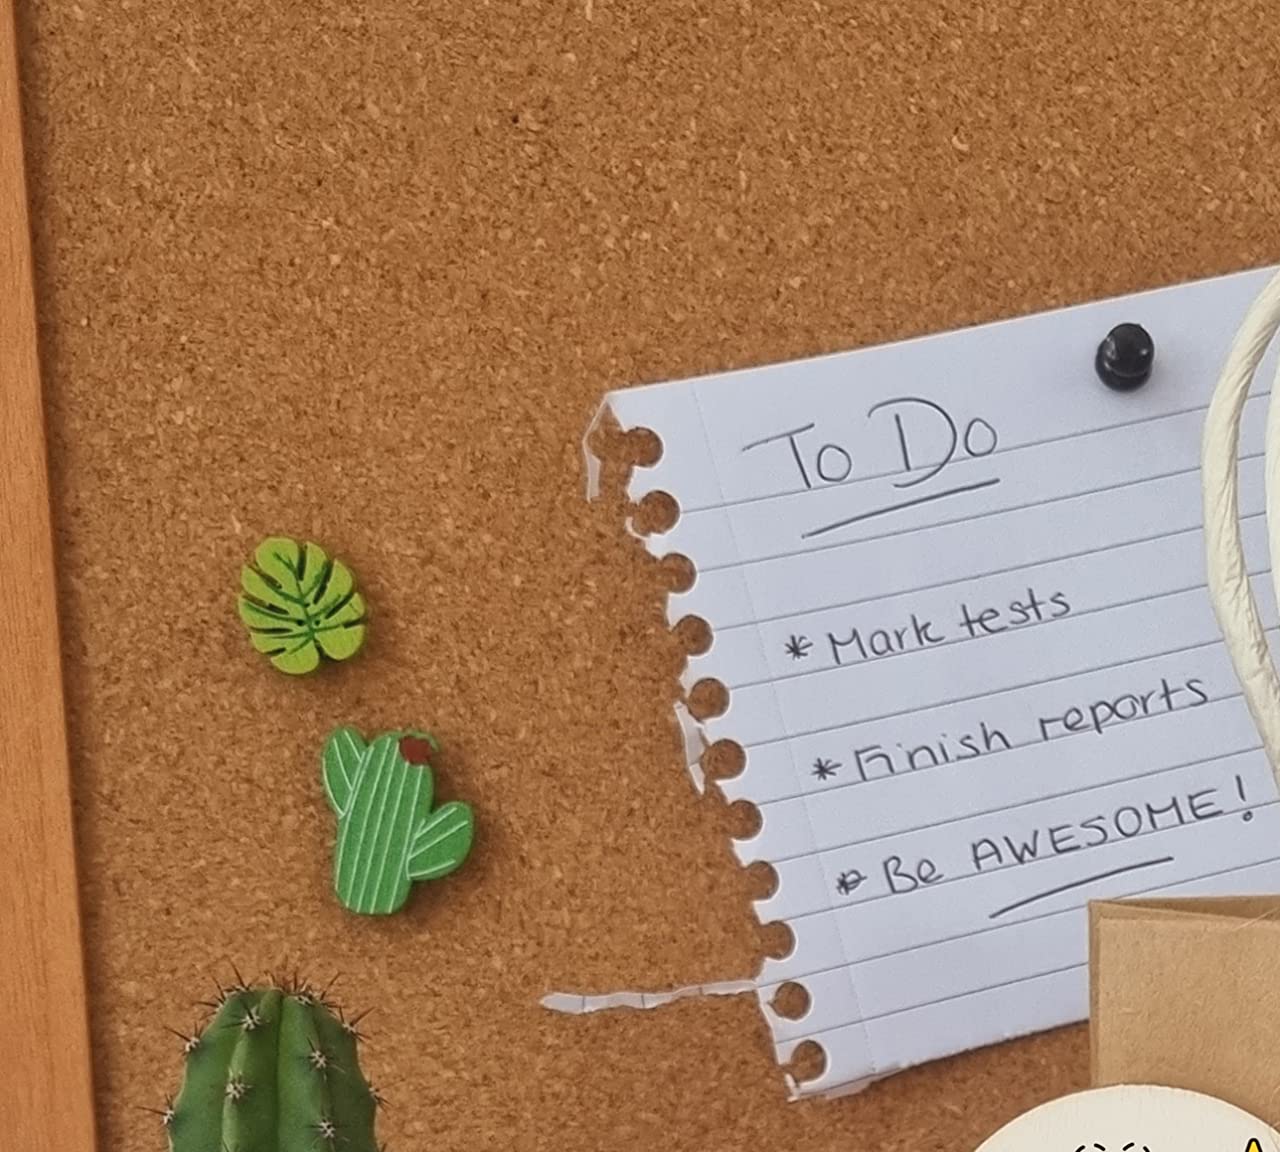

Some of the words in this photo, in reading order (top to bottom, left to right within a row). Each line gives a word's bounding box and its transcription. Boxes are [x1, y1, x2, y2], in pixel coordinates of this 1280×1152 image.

[741, 422, 853, 490] To
[867, 396, 999, 488] Do
[827, 614, 946, 665] Mark
[959, 587, 1072, 640] tests
[853, 721, 1012, 782] Finish
[1038, 677, 1210, 748] reports
[884, 854, 945, 895] Be
[970, 774, 1255, 873] AWESOME!
